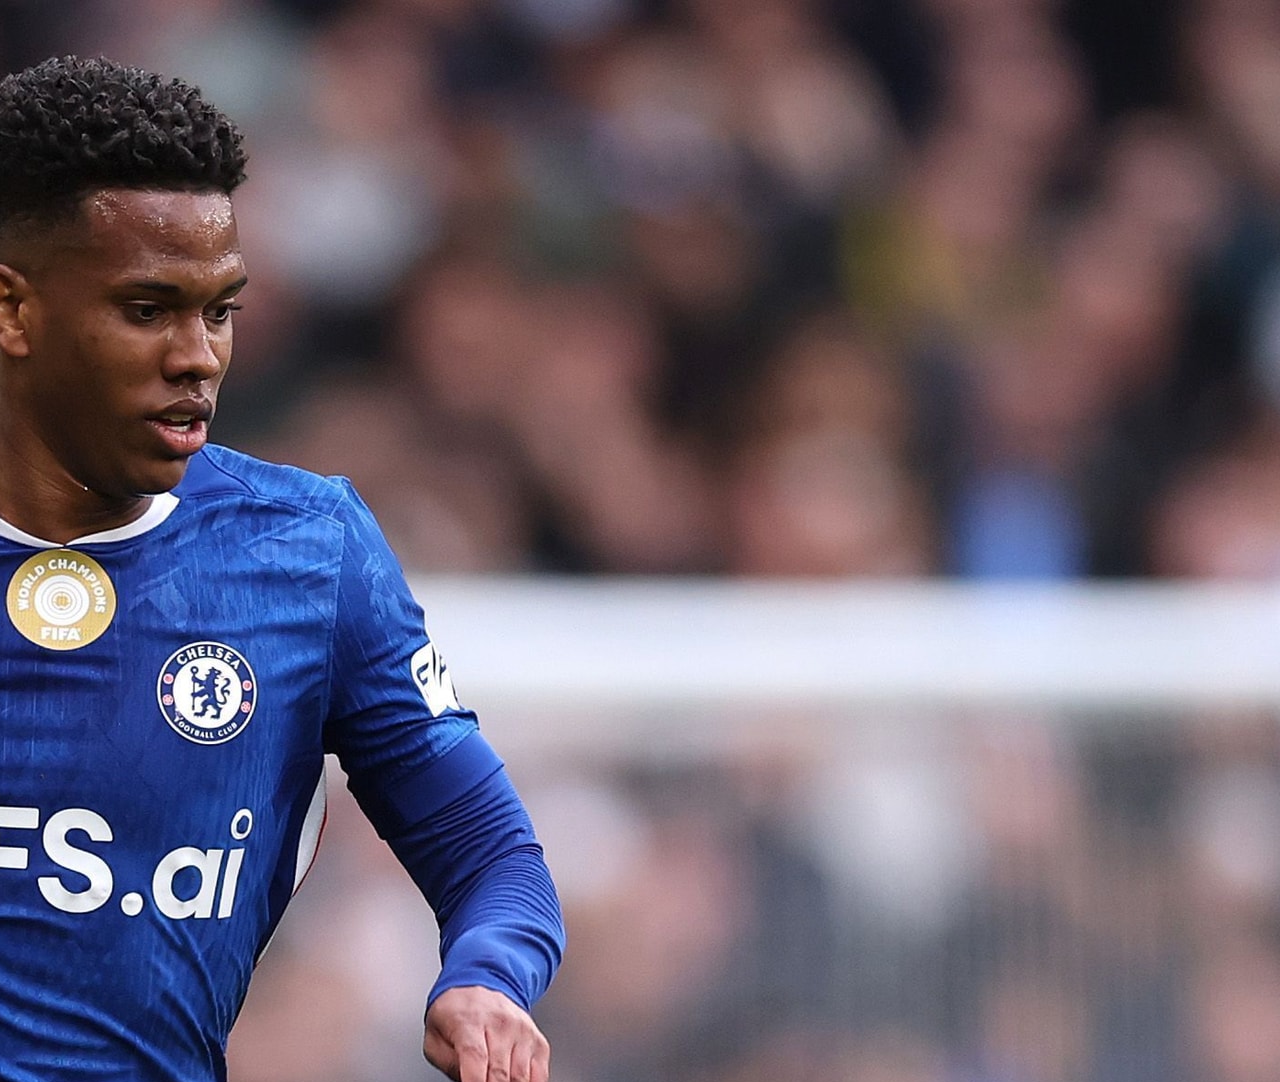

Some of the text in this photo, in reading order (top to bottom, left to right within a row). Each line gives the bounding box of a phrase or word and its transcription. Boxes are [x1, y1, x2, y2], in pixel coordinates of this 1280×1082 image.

[17, 558, 107, 613] WORLD CHAMPIONS
[40, 626, 82, 641] FIFA
[176, 645, 242, 671] CHELSEA
[217, 721, 238, 738] CLUB
